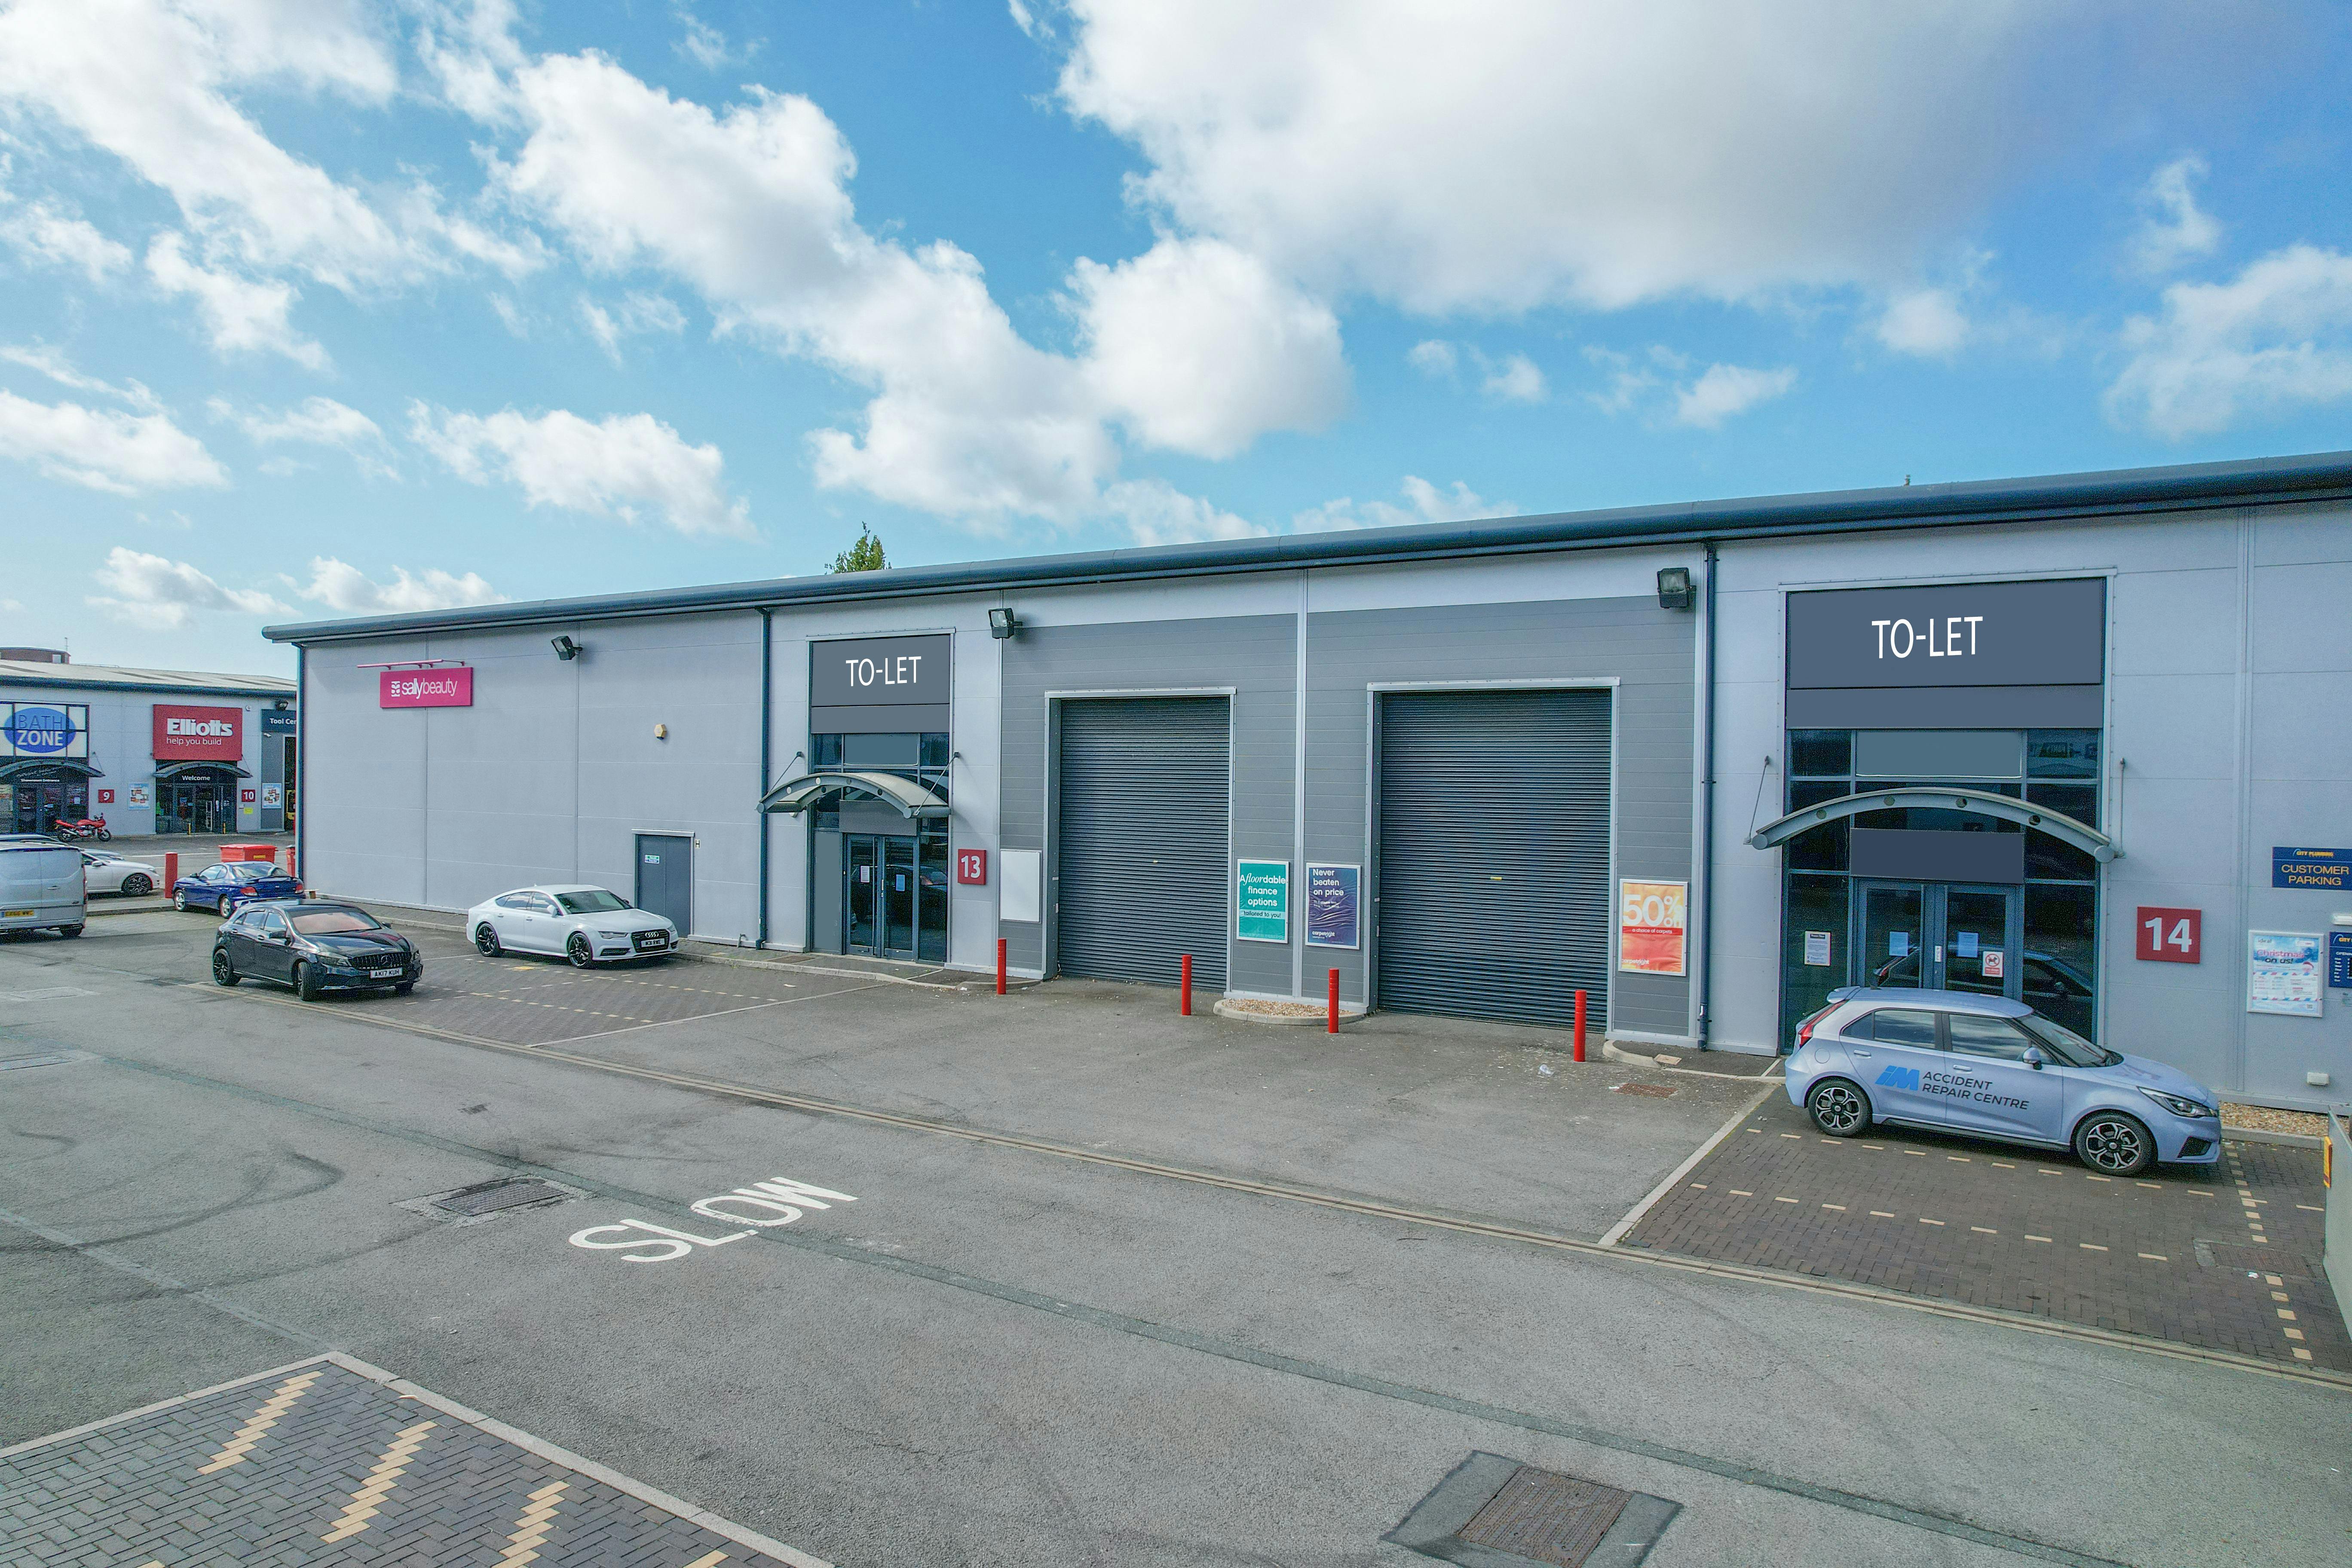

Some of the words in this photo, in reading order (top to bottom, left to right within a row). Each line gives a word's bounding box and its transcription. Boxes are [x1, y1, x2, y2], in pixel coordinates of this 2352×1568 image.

[1871, 616, 1983, 658] TO-LET
[846, 656, 921, 686] TO-LET
[18, 714, 63, 730] BATH
[167, 718, 233, 736] Elliotts
[17, 730, 63, 746] ZONE
[167, 737, 184, 746] help
[103, 791, 110, 801] 9
[243, 791, 254, 800] 10
[695, 840, 700, 848] H
[961, 855, 980, 878] 13
[2282, 864, 2349, 875] CUSTOMER
[1240, 873, 1286, 885] Afloordable
[2288, 875, 2341, 885] PARKING
[1248, 886, 1277, 895] finance
[1325, 888, 1344, 897] price
[1248, 898, 1277, 907] options
[1623, 894, 1680, 926] 50%
[2145, 917, 2192, 952] 14
[2257, 949, 2305, 958] Christmas
[1923, 1072, 1993, 1090] ACCIDENT
[1922, 1083, 1970, 1099] REPAIR
[1973, 1092, 2030, 1110] CENTRE
[569, 1177, 859, 1262] SLOW
